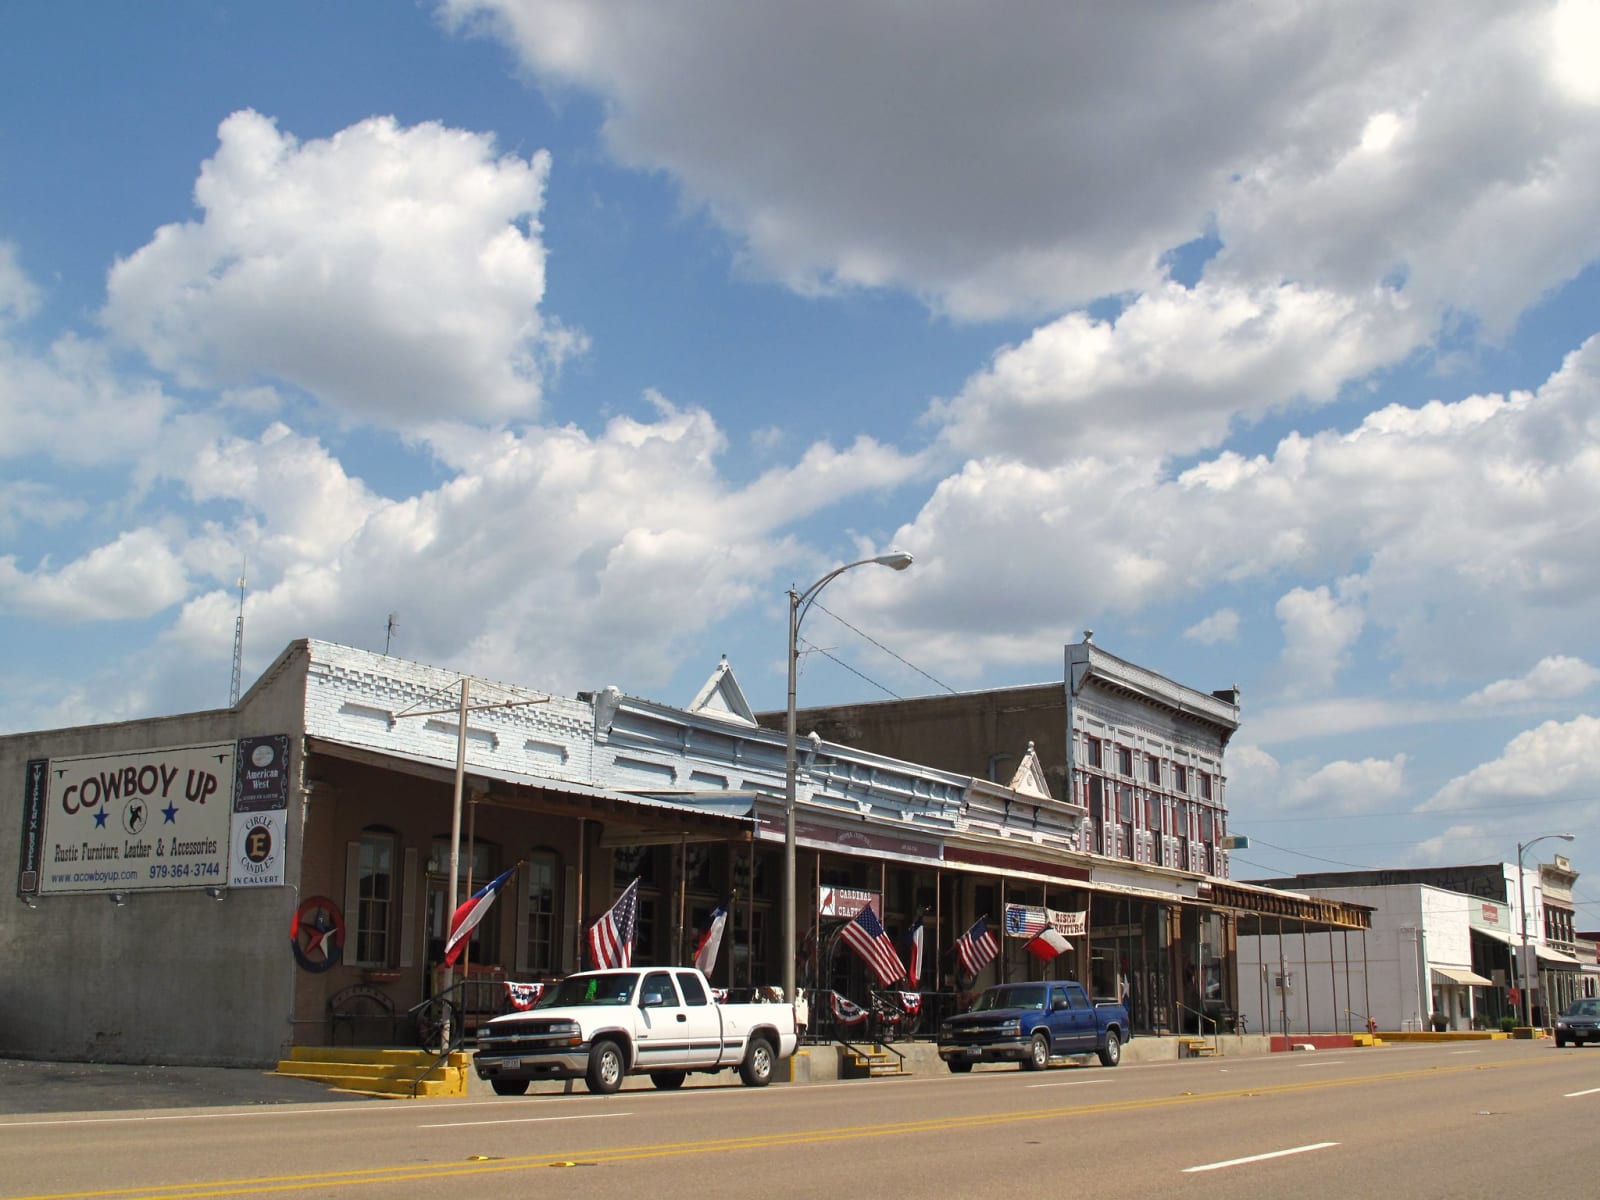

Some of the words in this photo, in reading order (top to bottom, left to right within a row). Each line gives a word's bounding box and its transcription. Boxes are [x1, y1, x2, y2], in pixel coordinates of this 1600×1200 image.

[246, 768, 279, 780] American
[62, 762, 179, 815] COWBOY
[185, 769, 217, 804] UP
[252, 779, 270, 790] West
[245, 815, 273, 830] CIRCLE
[54, 843, 79, 863] Rustic
[81, 842, 120, 861] Furniture,
[124, 839, 152, 859] Leather
[156, 837, 164, 857] &
[170, 836, 217, 857] Accessories
[250, 833, 267, 857] E
[241, 855, 275, 874] CANDLES
[51, 869, 138, 883] www.acowboyup.com
[234, 877, 241, 885] IN
[243, 875, 279, 884] CALVERT
[839, 889, 872, 901] CARDINAL
